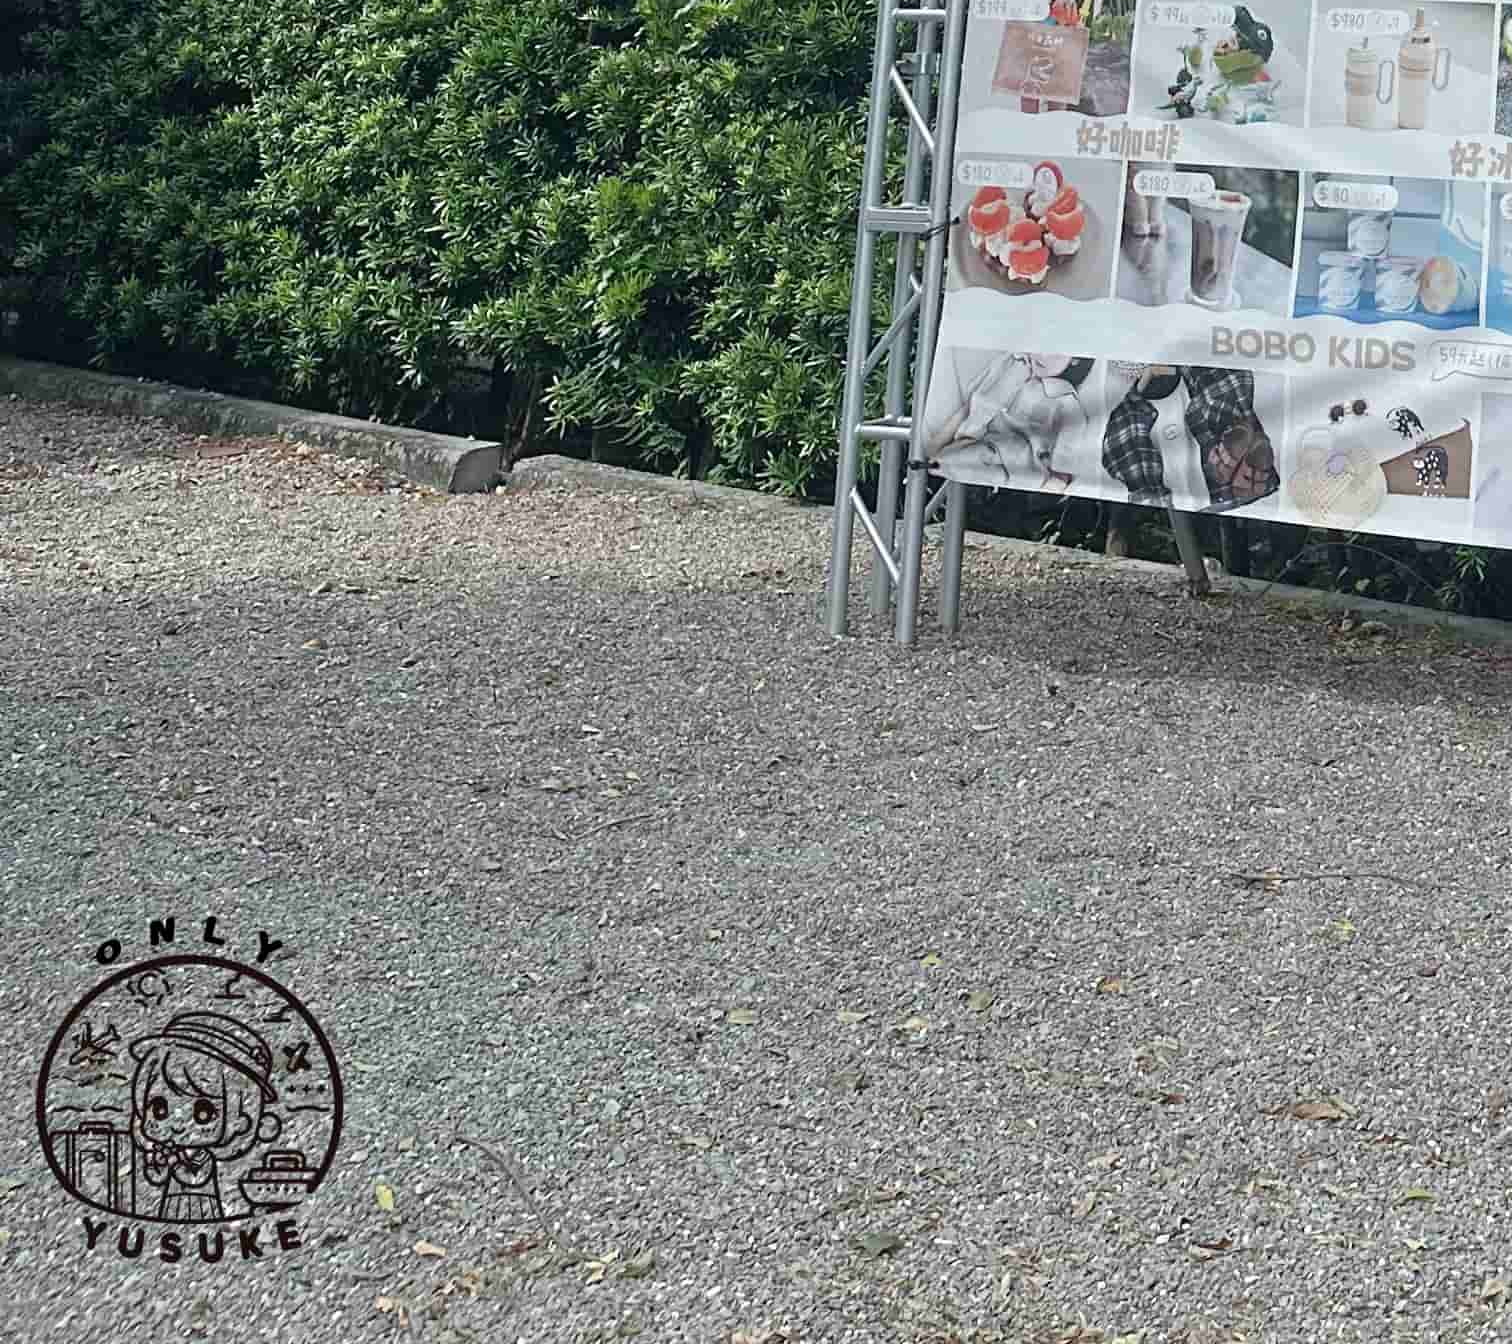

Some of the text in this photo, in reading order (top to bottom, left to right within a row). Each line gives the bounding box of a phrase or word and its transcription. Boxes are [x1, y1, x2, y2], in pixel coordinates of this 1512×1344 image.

[1076, 120, 1182, 160] 好咖啡
[1210, 325, 1316, 362] BOBO
[1328, 334, 1417, 372] KIDS
